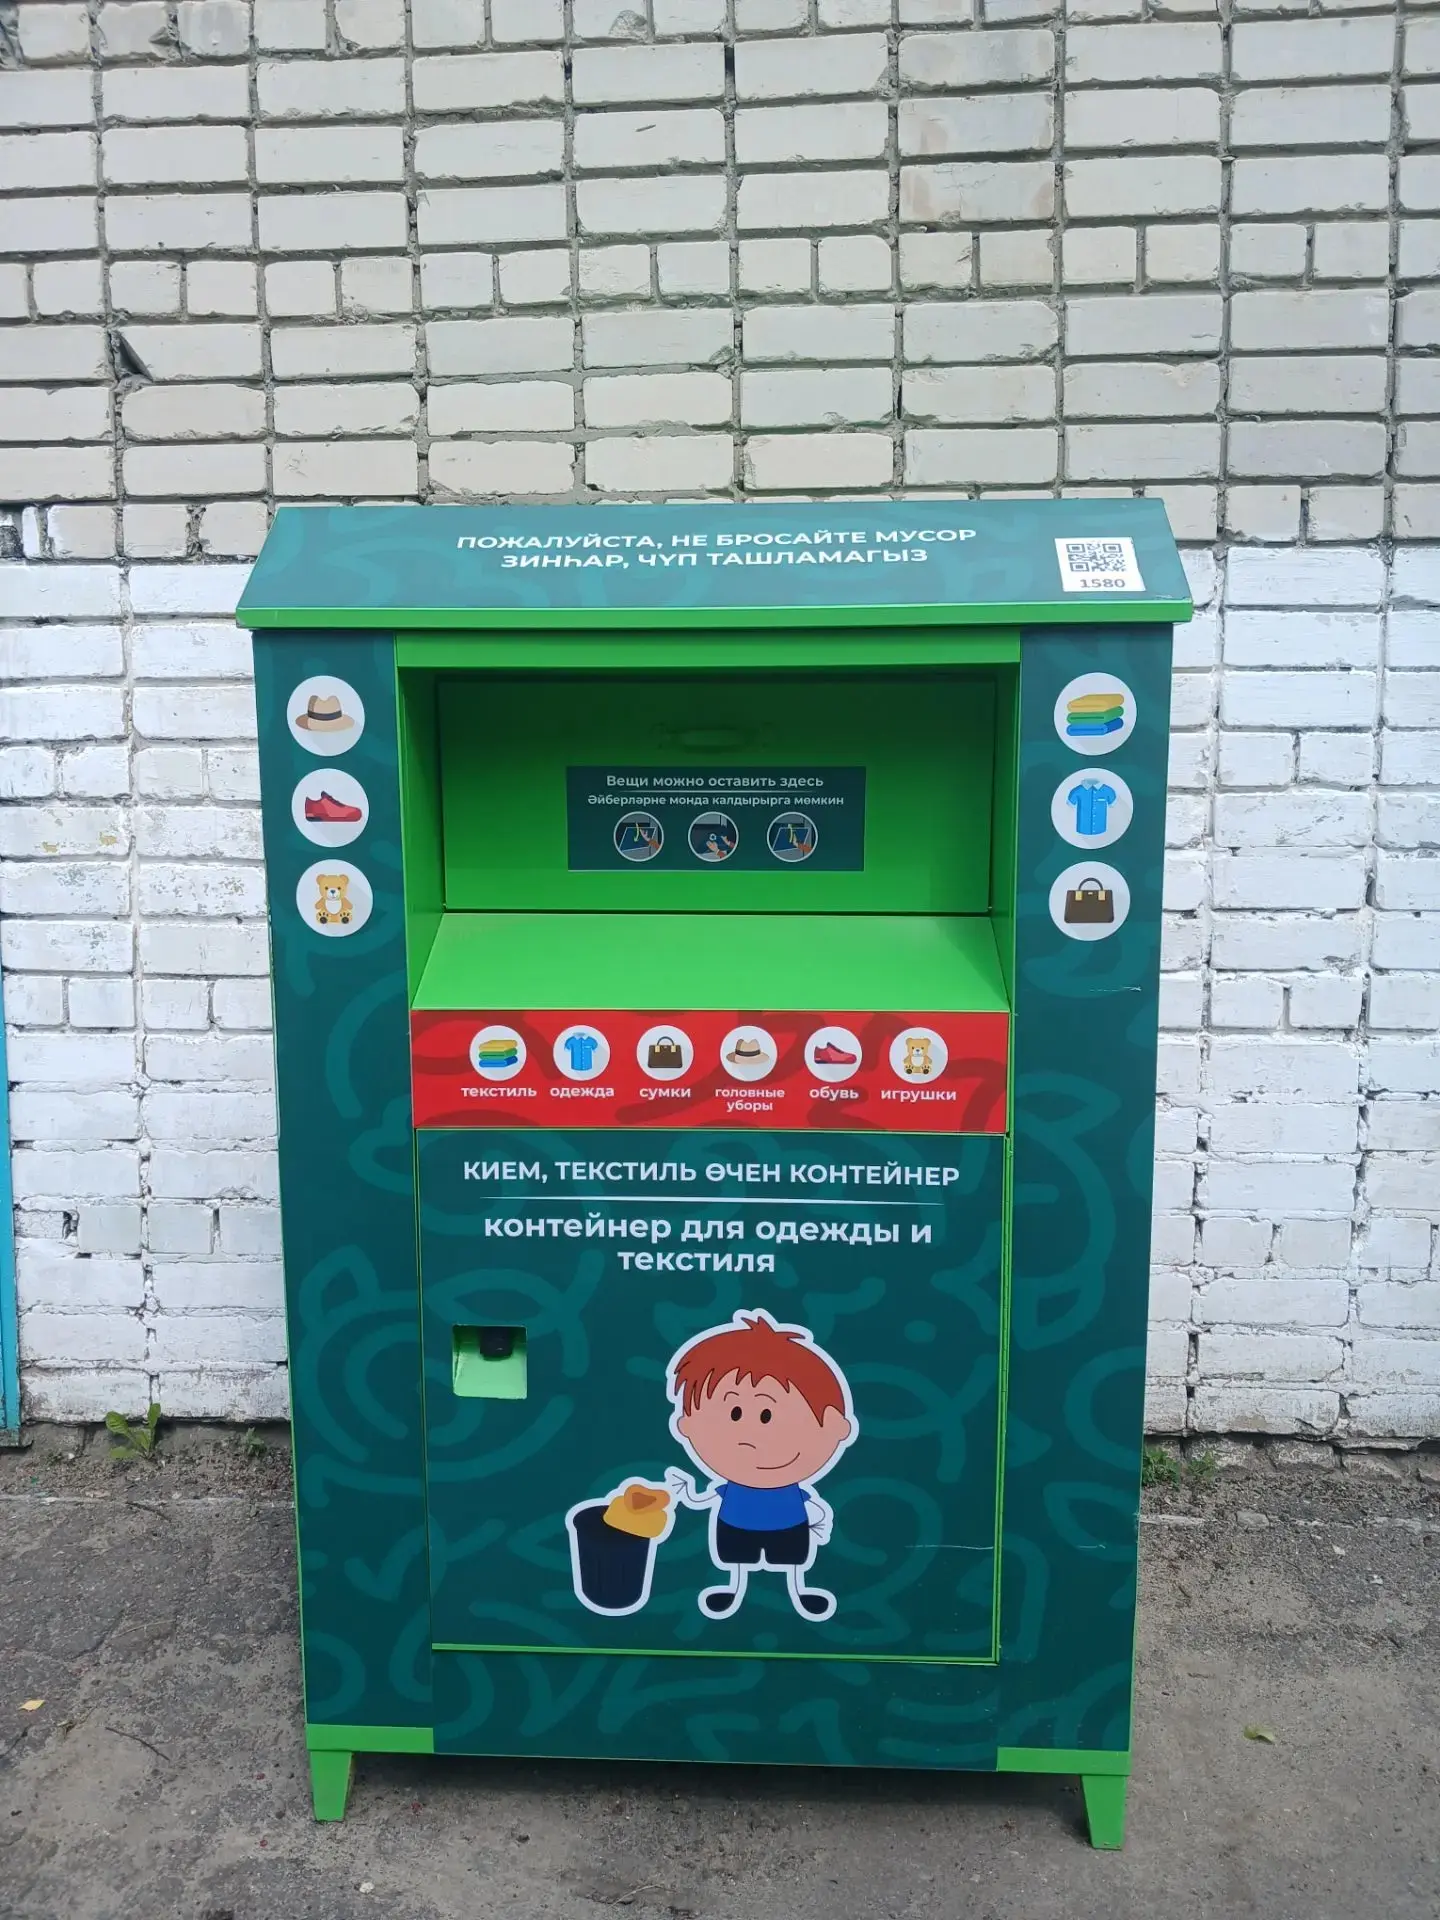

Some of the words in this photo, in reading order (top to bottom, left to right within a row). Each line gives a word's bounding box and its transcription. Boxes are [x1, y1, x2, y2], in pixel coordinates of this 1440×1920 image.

[456, 533, 664, 550] ПОЖАЛУЙСТА,
[671, 533, 709, 548] НЕ
[716, 528, 868, 547] БРОСАЙТЕ
[875, 529, 977, 543] МУСОР
[638, 553, 698, 567] ЧҮП
[706, 549, 928, 566] ТАШЛАМАГЫЗ
[1079, 578, 1126, 589] 1580
[606, 774, 649, 788] Вещи
[653, 777, 705, 787] можно
[708, 777, 777, 787] оставить
[779, 777, 824, 789] здесь
[587, 794, 667, 807] Әйберләрне
[669, 796, 709, 807] монда
[712, 796, 791, 808] калдырырга
[794, 797, 844, 806] мөмкин
[460, 1086, 538, 1098] текстиль
[549, 1085, 615, 1100] одежда
[639, 1086, 691, 1101] сумки
[714, 1087, 786, 1098] головные
[808, 1085, 859, 1102] обувь
[880, 1087, 957, 1103] игрушки
[726, 1099, 774, 1114] уборы
[463, 1161, 548, 1184] КИЕМ,
[554, 1161, 697, 1182] ТЕКСТИЛЬ
[705, 1163, 781, 1184] ӨЧЕН
[790, 1161, 960, 1187] КОНТЕЙНЕР
[484, 1211, 672, 1244] контейнер
[680, 1218, 745, 1243] для
[755, 1221, 900, 1246] одежды
[911, 1224, 932, 1244] и
[617, 1251, 775, 1273] текстиля
